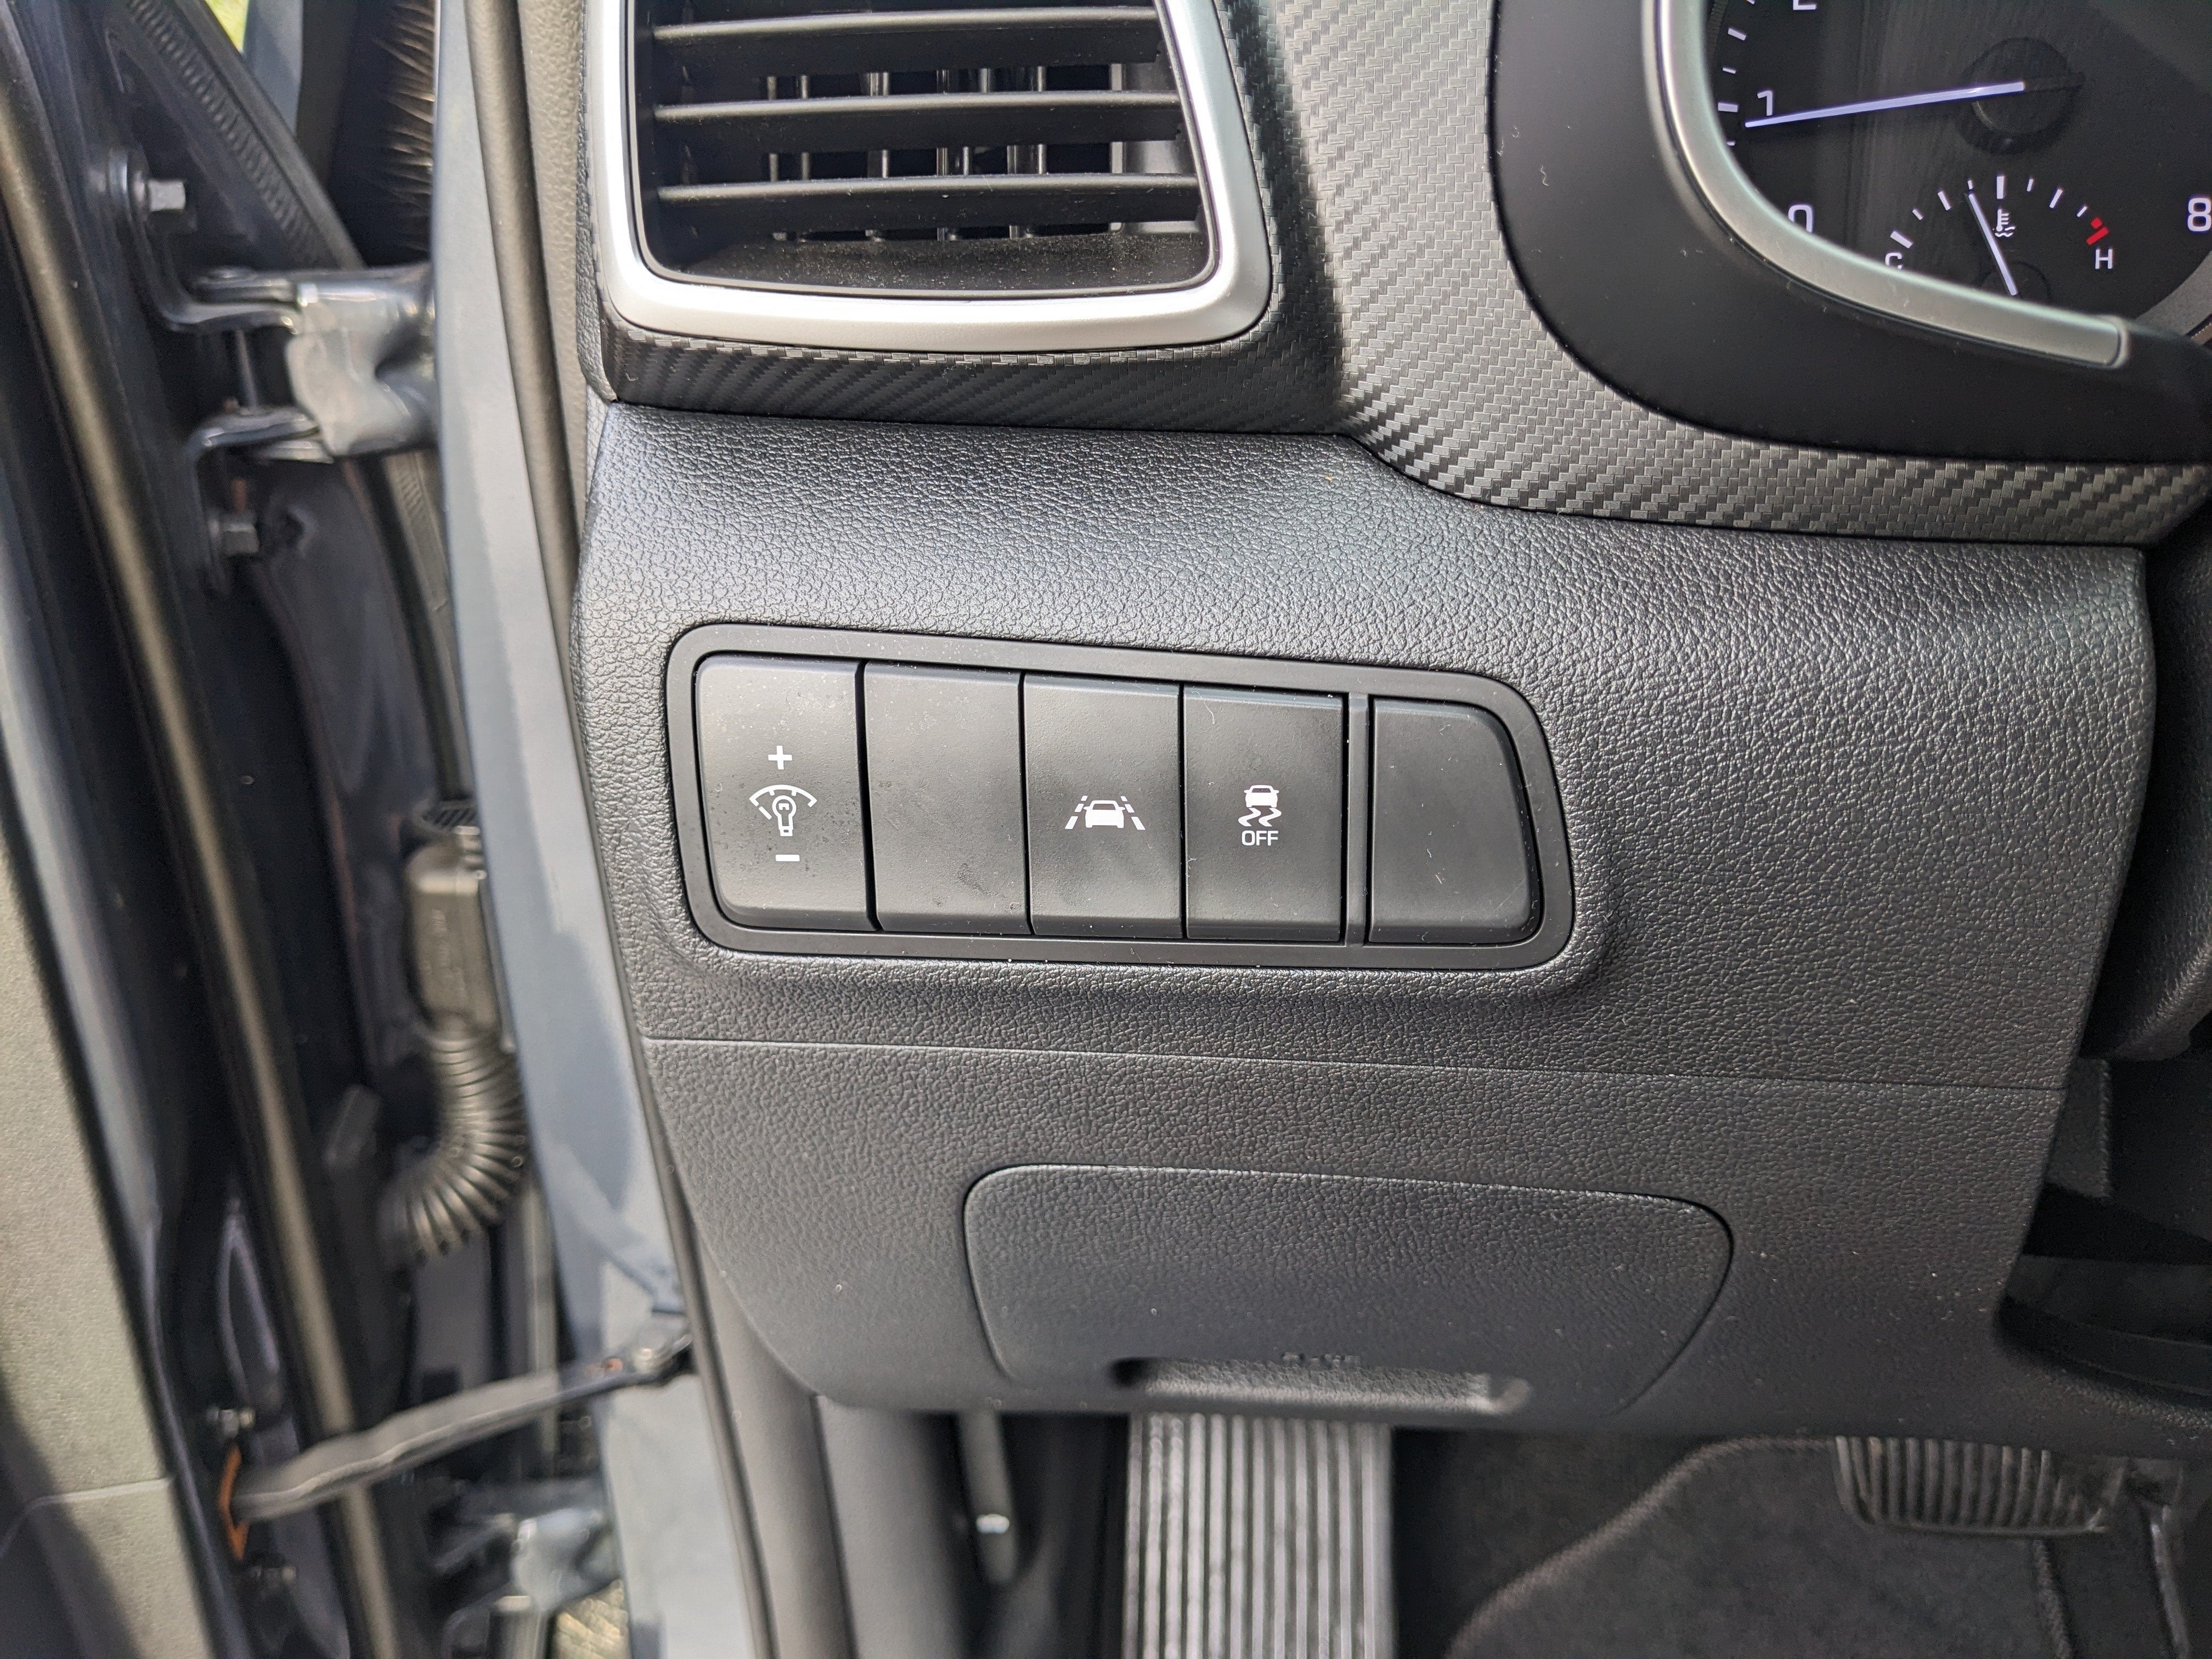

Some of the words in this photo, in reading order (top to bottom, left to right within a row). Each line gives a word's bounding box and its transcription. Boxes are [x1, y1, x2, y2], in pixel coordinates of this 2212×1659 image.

[1757, 89, 1774, 117] 1
[2187, 197, 2212, 232] 8
[2095, 248, 2113, 269] H
[1242, 830, 1279, 846] OFF
